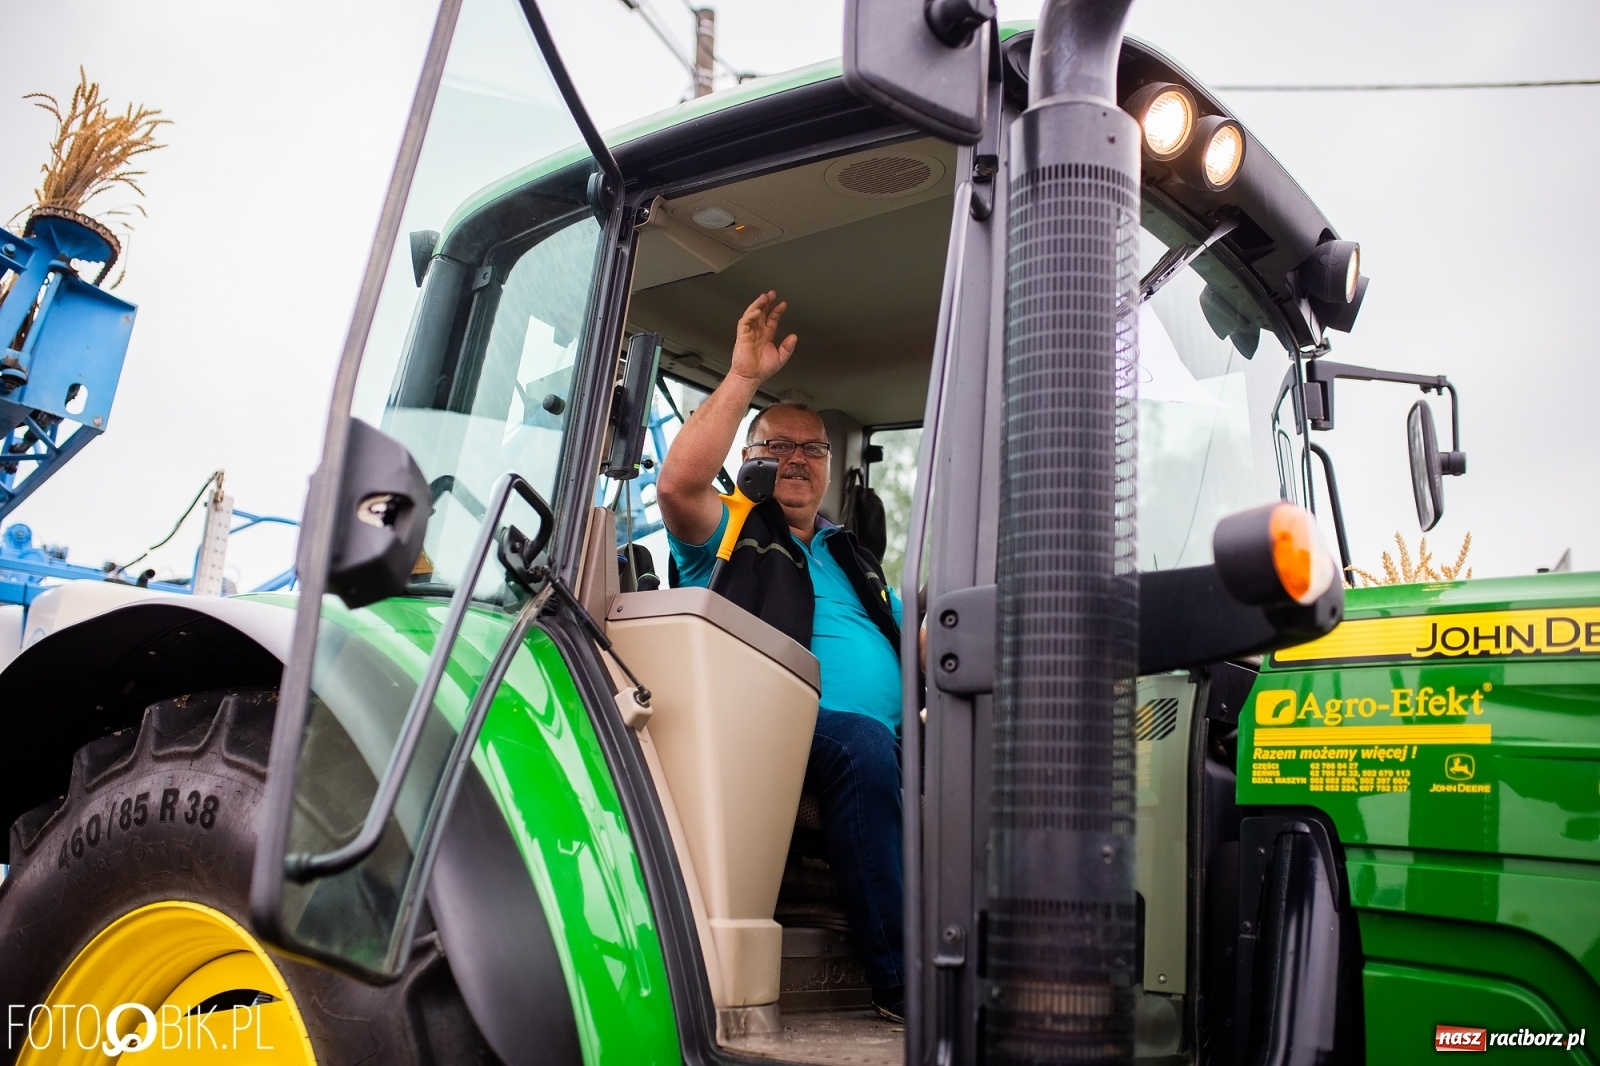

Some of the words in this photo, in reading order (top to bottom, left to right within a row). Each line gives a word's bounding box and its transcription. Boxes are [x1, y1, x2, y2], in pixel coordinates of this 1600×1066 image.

[1416, 623, 1534, 652] JOHN
[1253, 747, 1297, 760] Razem
[1300, 746, 1358, 762] możemy
[1361, 746, 1409, 762] więcej
[1411, 746, 1418, 759] !
[1348, 762, 1359, 770] 27
[1429, 783, 1456, 793] JOHN
[1457, 783, 1491, 793] DEERE
[57, 791, 150, 870] 460/85
